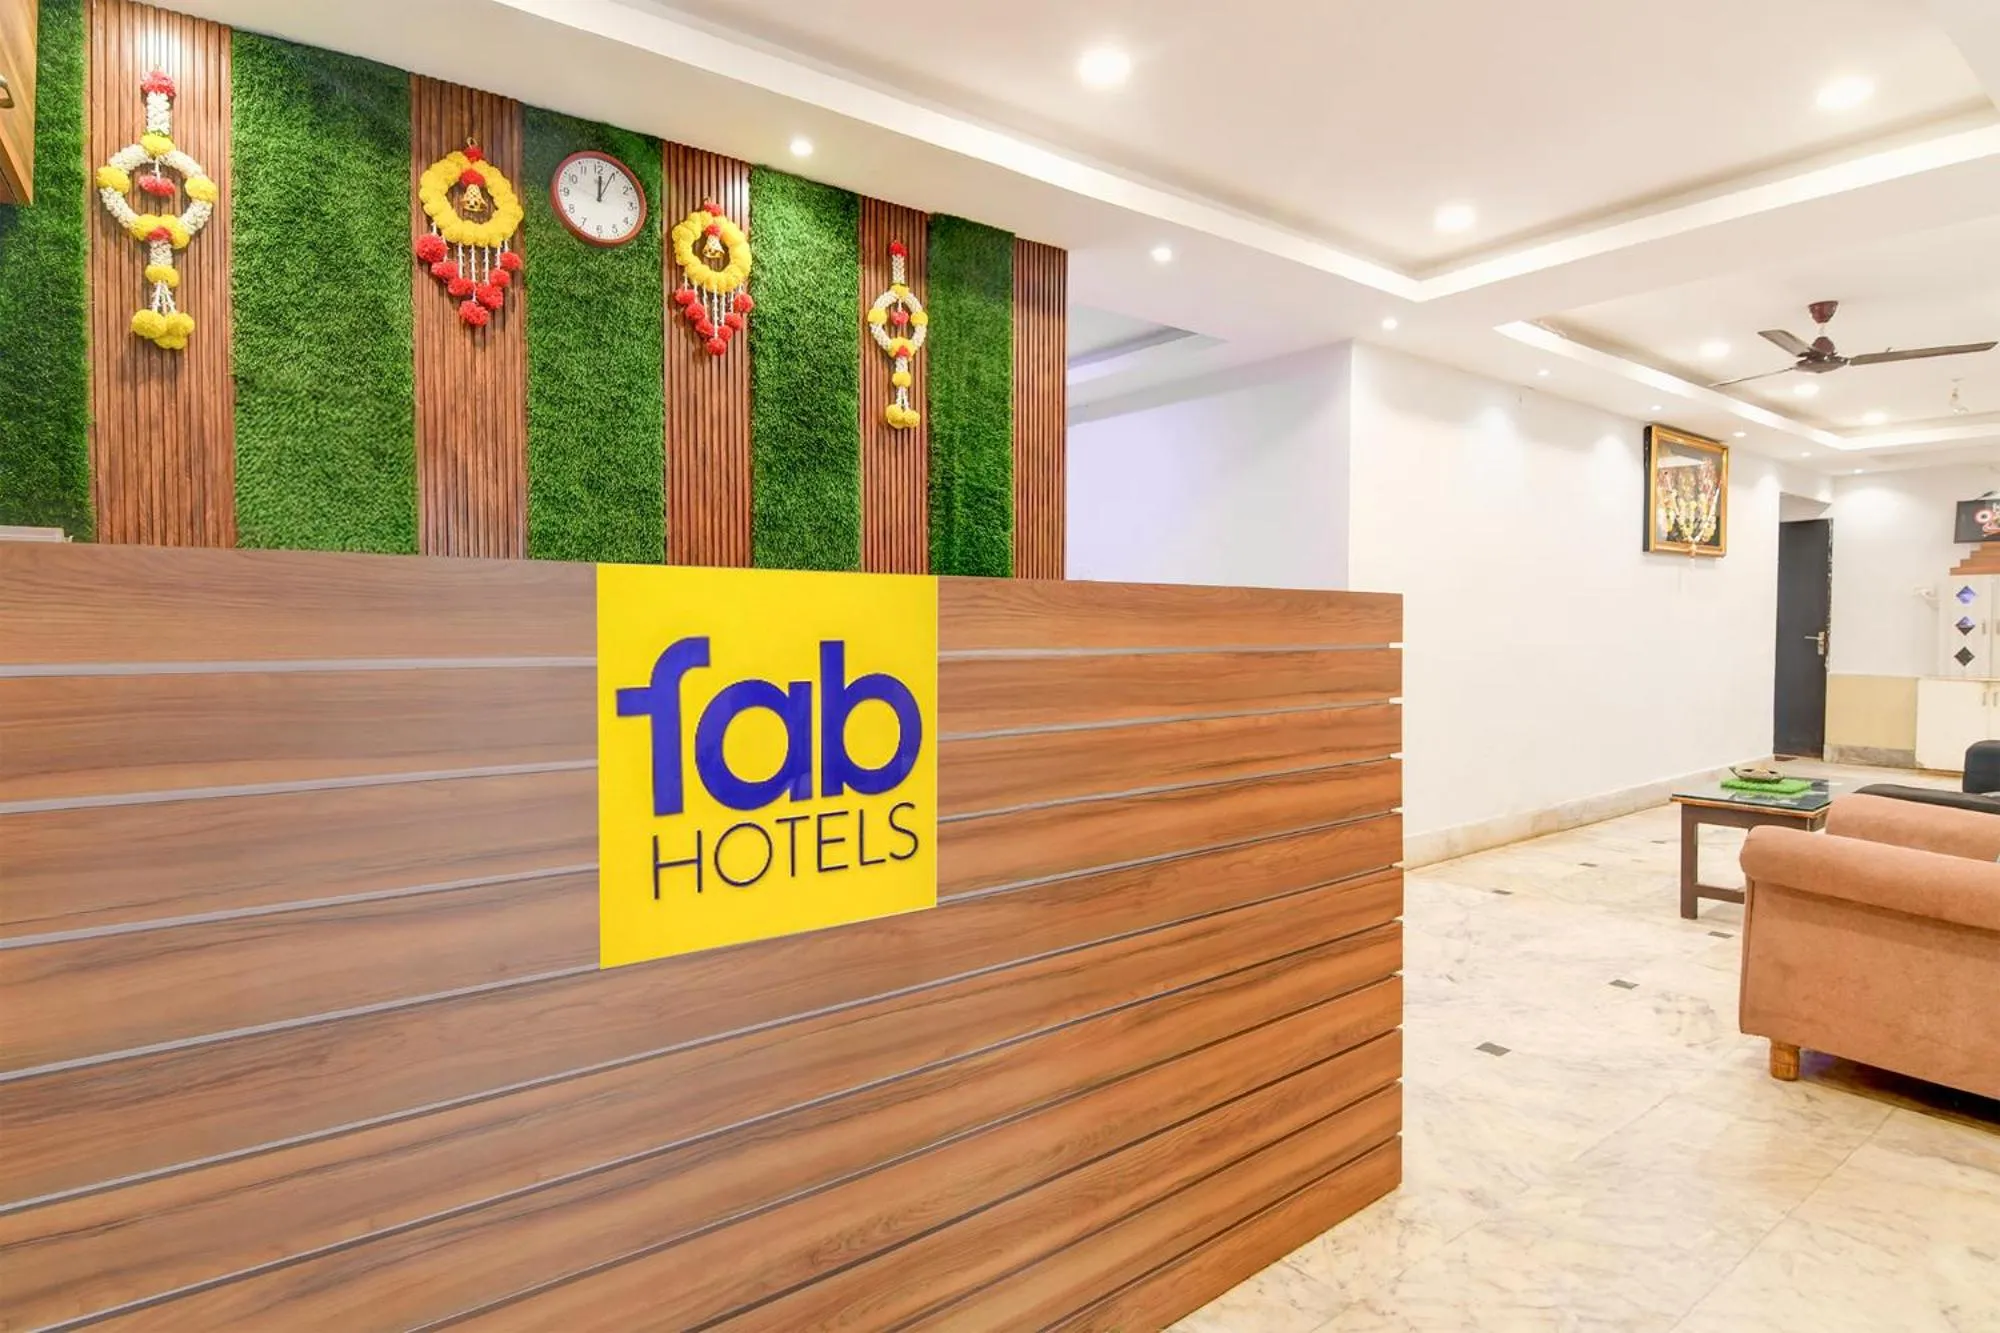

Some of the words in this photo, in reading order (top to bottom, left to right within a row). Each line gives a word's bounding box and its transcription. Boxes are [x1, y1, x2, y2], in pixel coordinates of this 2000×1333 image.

[581, 165, 587, 175] 11
[594, 164, 603, 175] 12
[569, 174, 578, 184] 10
[563, 187, 570, 197] 9
[623, 185, 629, 195] 2
[568, 204, 575, 214] 8
[629, 201, 634, 211] 3
[581, 217, 587, 226] 7
[623, 217, 629, 225] 4
[596, 225, 603, 234] 6
[612, 224, 618, 233] 5
[616, 636, 922, 816] fab
[653, 802, 918, 900] HOTELS
